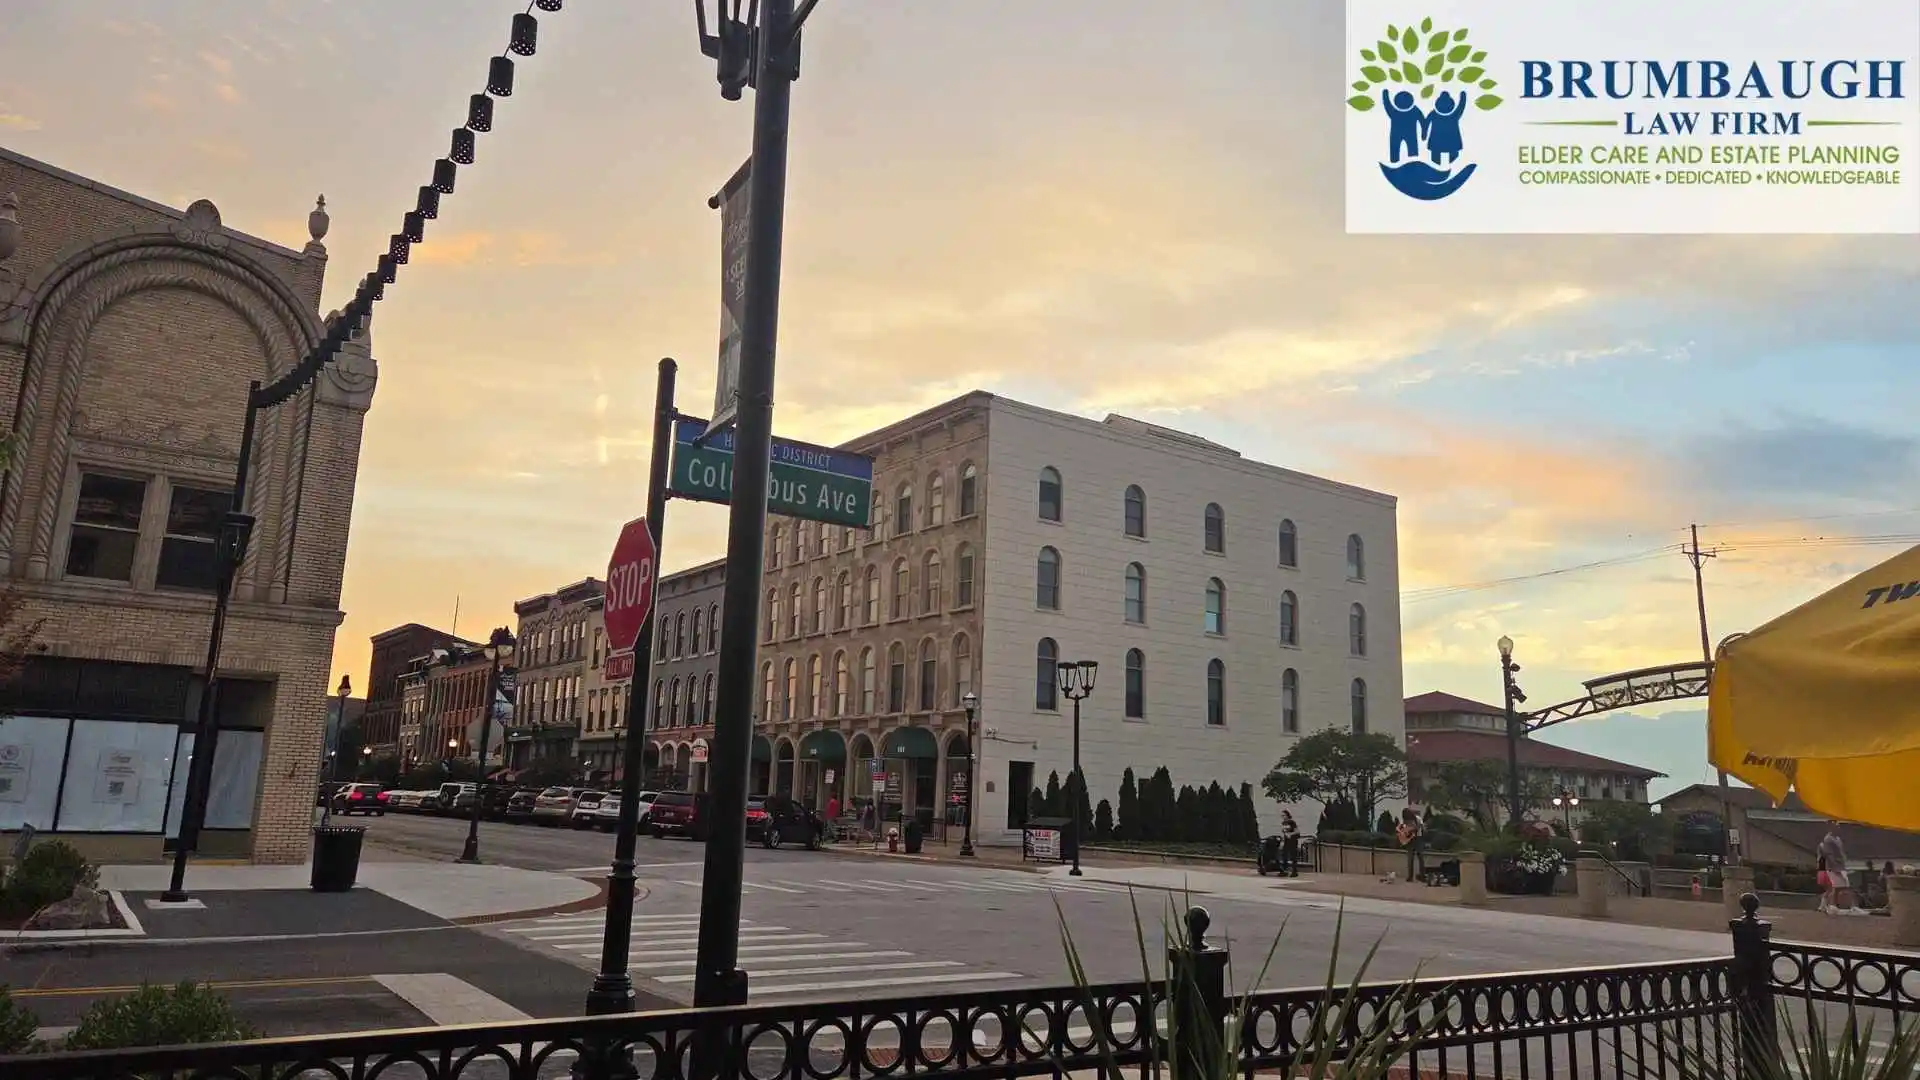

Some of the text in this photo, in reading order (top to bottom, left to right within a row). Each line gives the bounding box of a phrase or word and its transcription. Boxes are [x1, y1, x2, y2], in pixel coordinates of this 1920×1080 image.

[688, 458, 857, 514] Colbus Ave
[782, 446, 832, 471] DISTRICT
[607, 557, 651, 612] STOP
